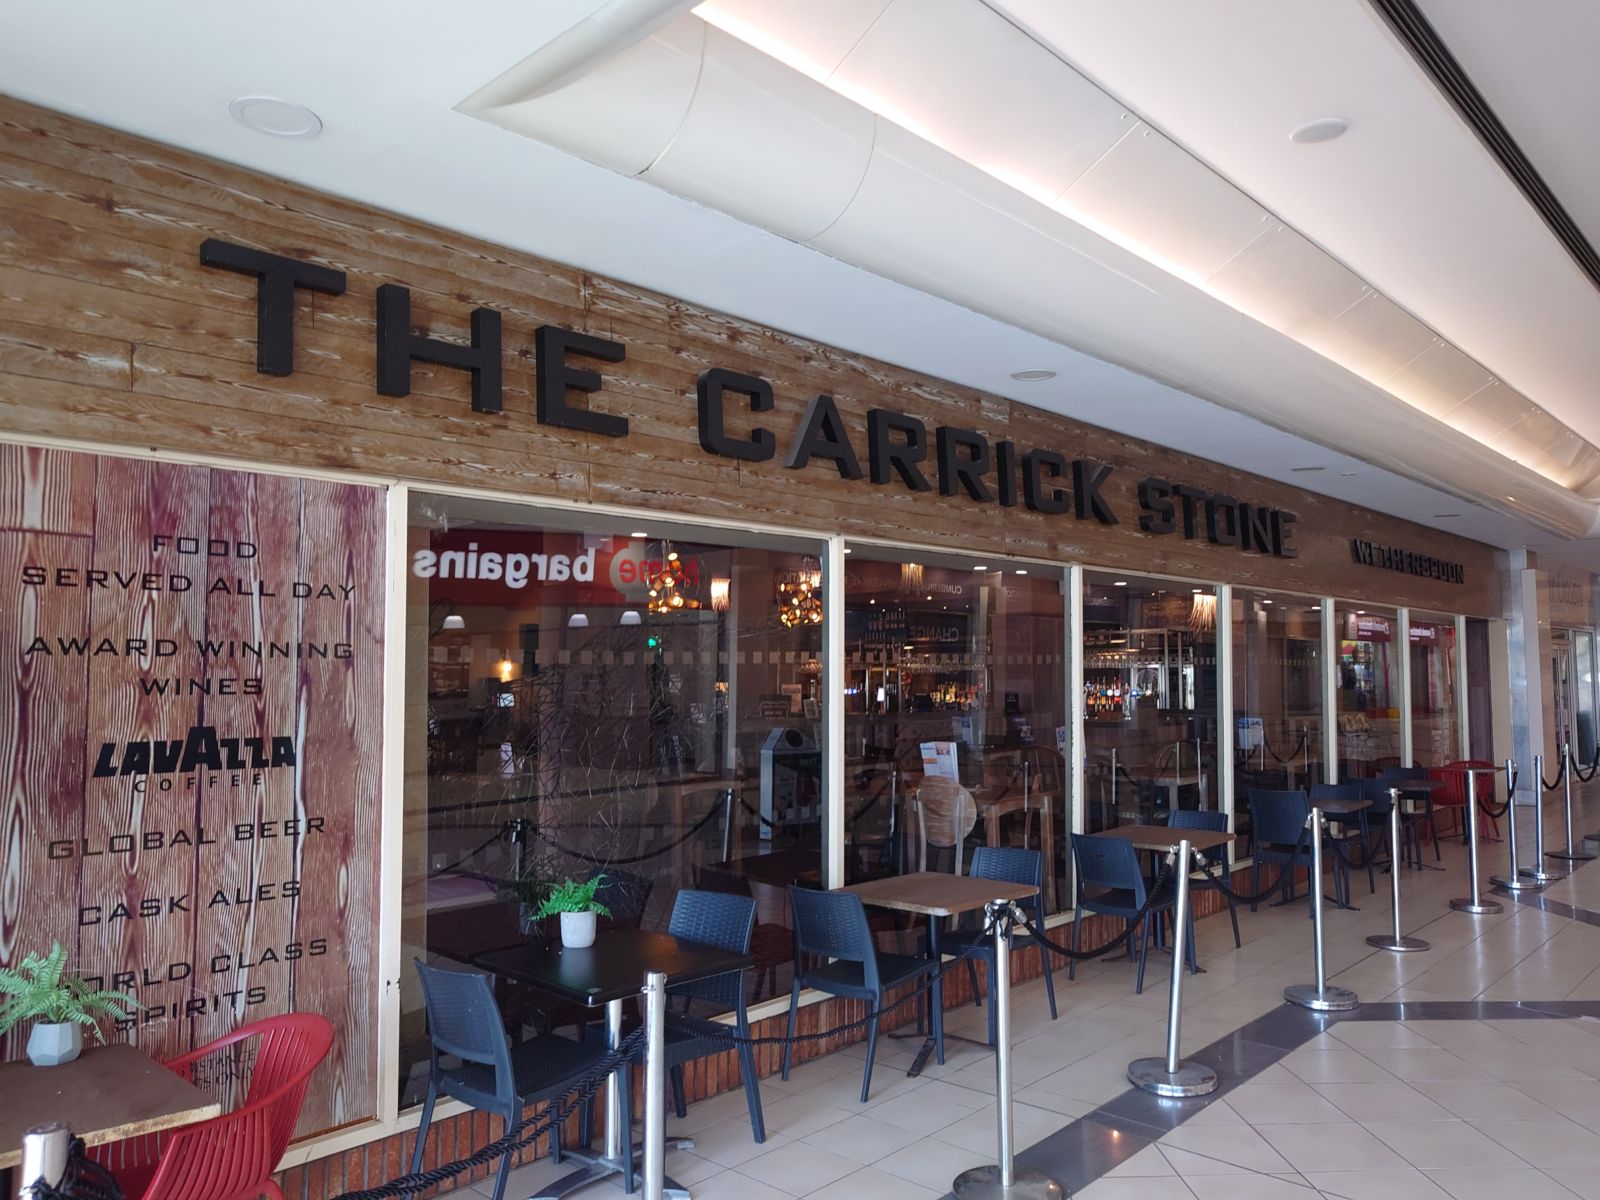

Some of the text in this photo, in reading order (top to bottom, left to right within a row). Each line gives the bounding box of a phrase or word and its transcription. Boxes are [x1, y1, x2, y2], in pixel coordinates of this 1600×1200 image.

[200, 237, 1299, 559] THE CARRICK STONE
[153, 535, 258, 559] FOOD
[22, 566, 356, 601] SERVED ALL DAY
[25, 637, 354, 660] AWARD WINNING
[140, 677, 263, 696] WINES
[134, 772, 263, 793] COFFEE
[48, 816, 326, 861] GLOBAL BEER
[79, 880, 301, 927] CASK ALES
[210, 938, 328, 974] CLASS
[115, 986, 267, 1033] SPIRITS
